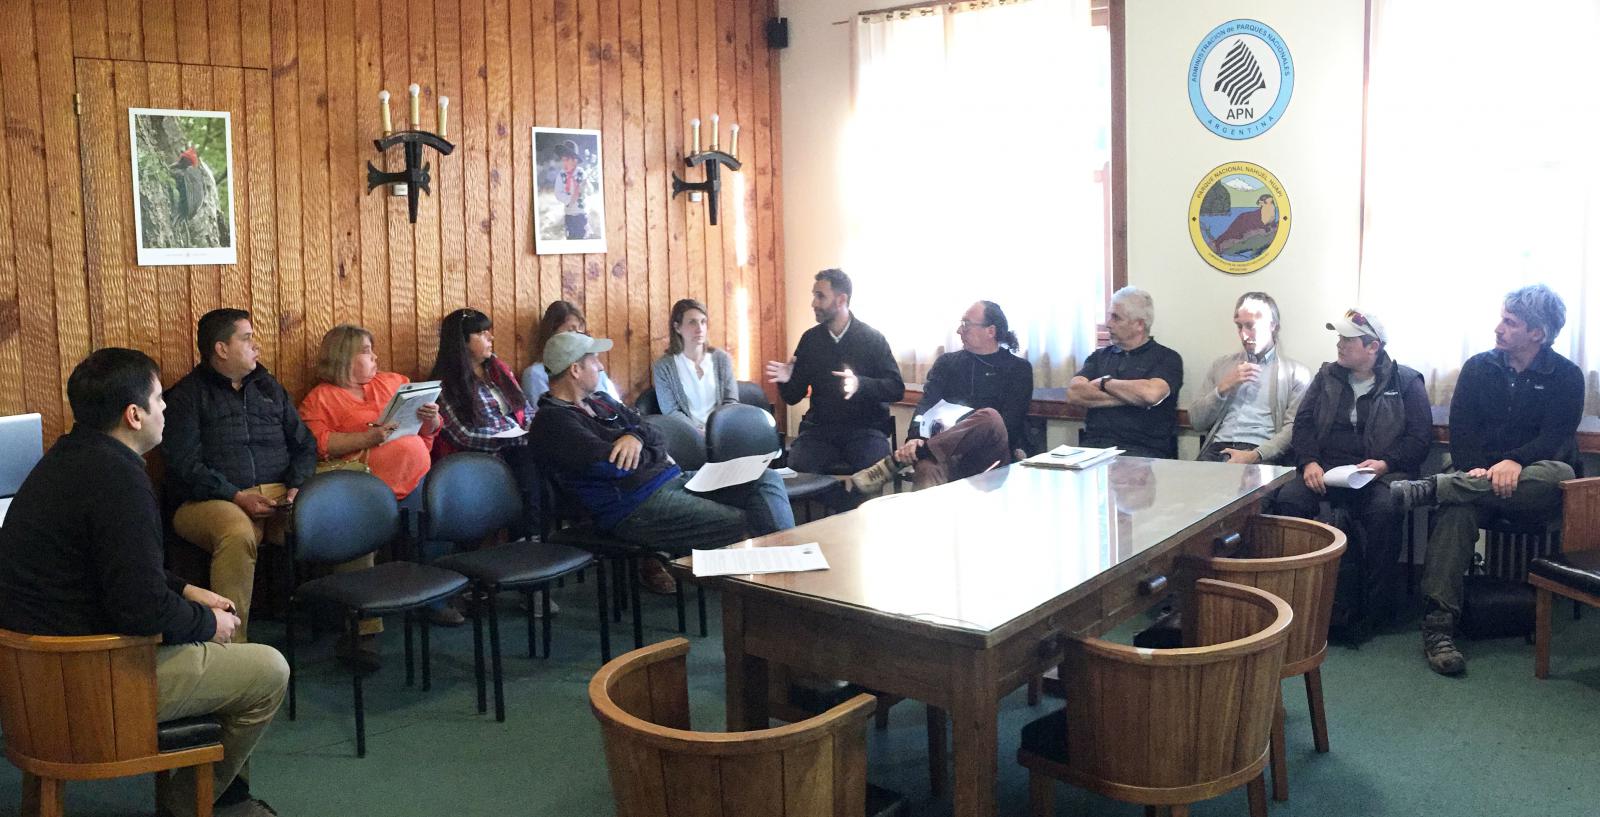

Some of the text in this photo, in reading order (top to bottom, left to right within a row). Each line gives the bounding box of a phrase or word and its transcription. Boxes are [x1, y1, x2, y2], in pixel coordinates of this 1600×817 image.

[1191, 29, 1226, 82] ADMINISTRACION
[1236, 23, 1267, 36] PARQUES
[1266, 33, 1290, 76] NACIONALES
[1207, 116, 1274, 135] ARGENTINA
[1226, 107, 1254, 120] APN
[1197, 166, 1282, 198] PARQUE NACIONAL NAHUEL HUAPI
